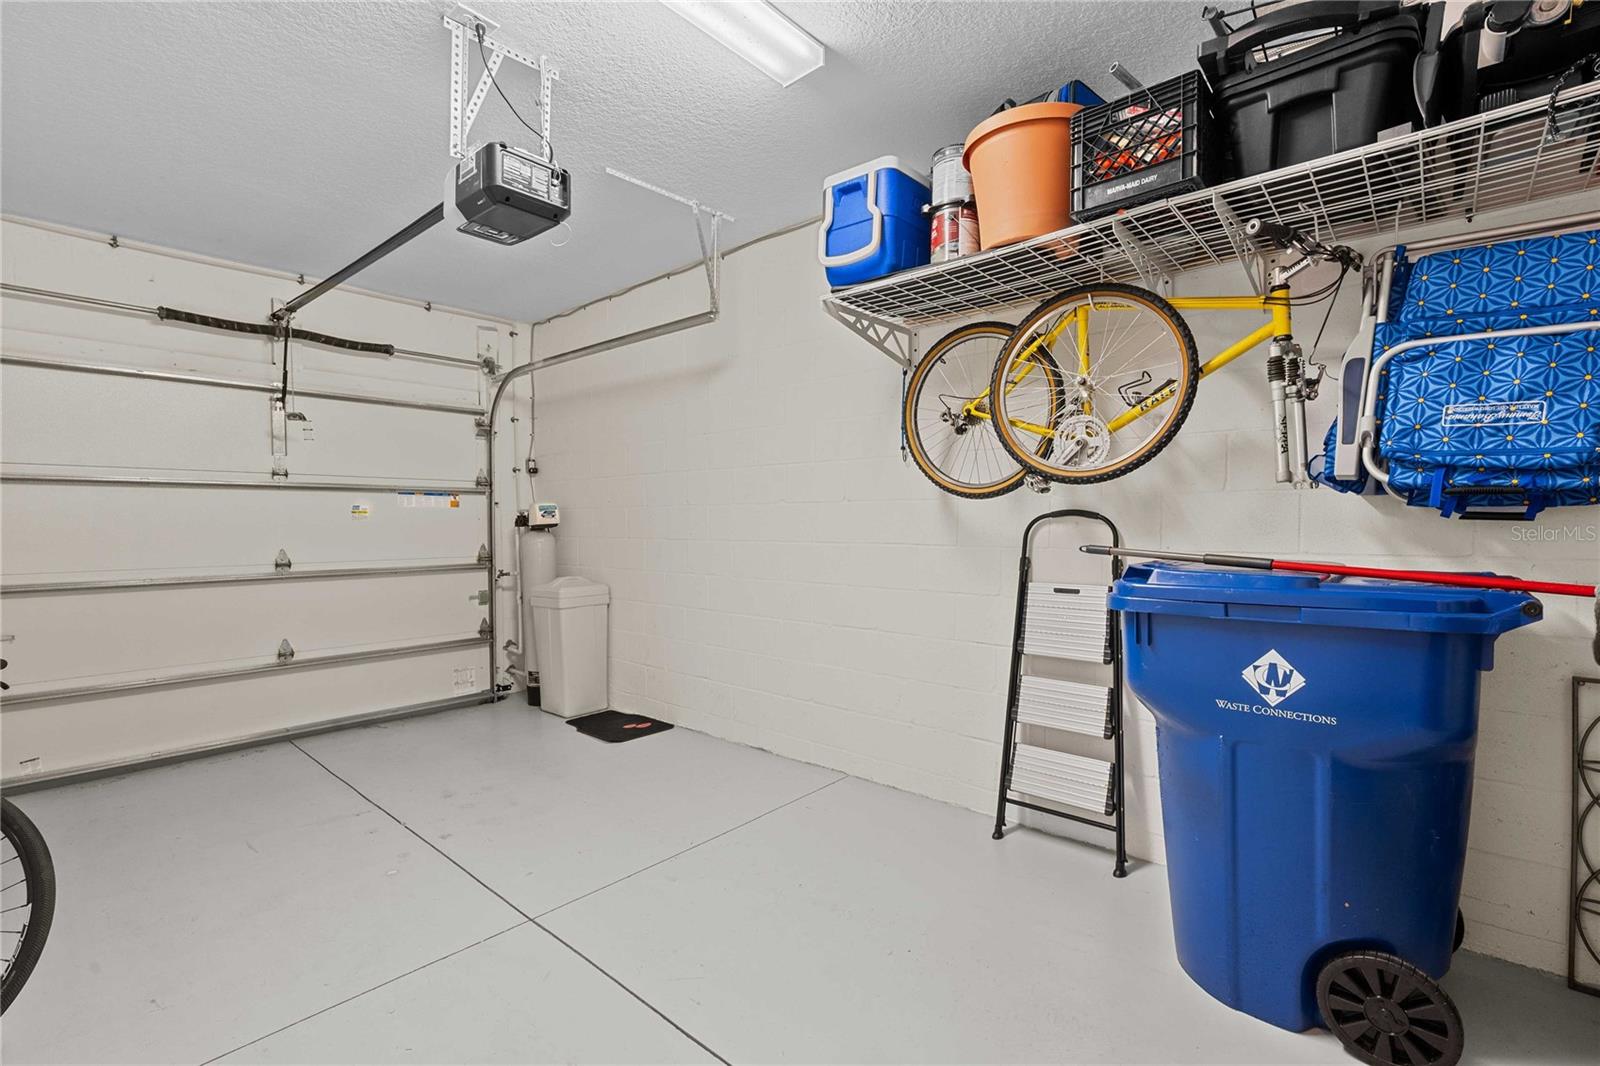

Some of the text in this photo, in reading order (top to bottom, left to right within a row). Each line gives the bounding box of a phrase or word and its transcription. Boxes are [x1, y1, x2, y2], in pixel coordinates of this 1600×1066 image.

[1141, 174, 1158, 185] DAIRY
[1215, 699, 1338, 726] WASTE CONNECTIONS
